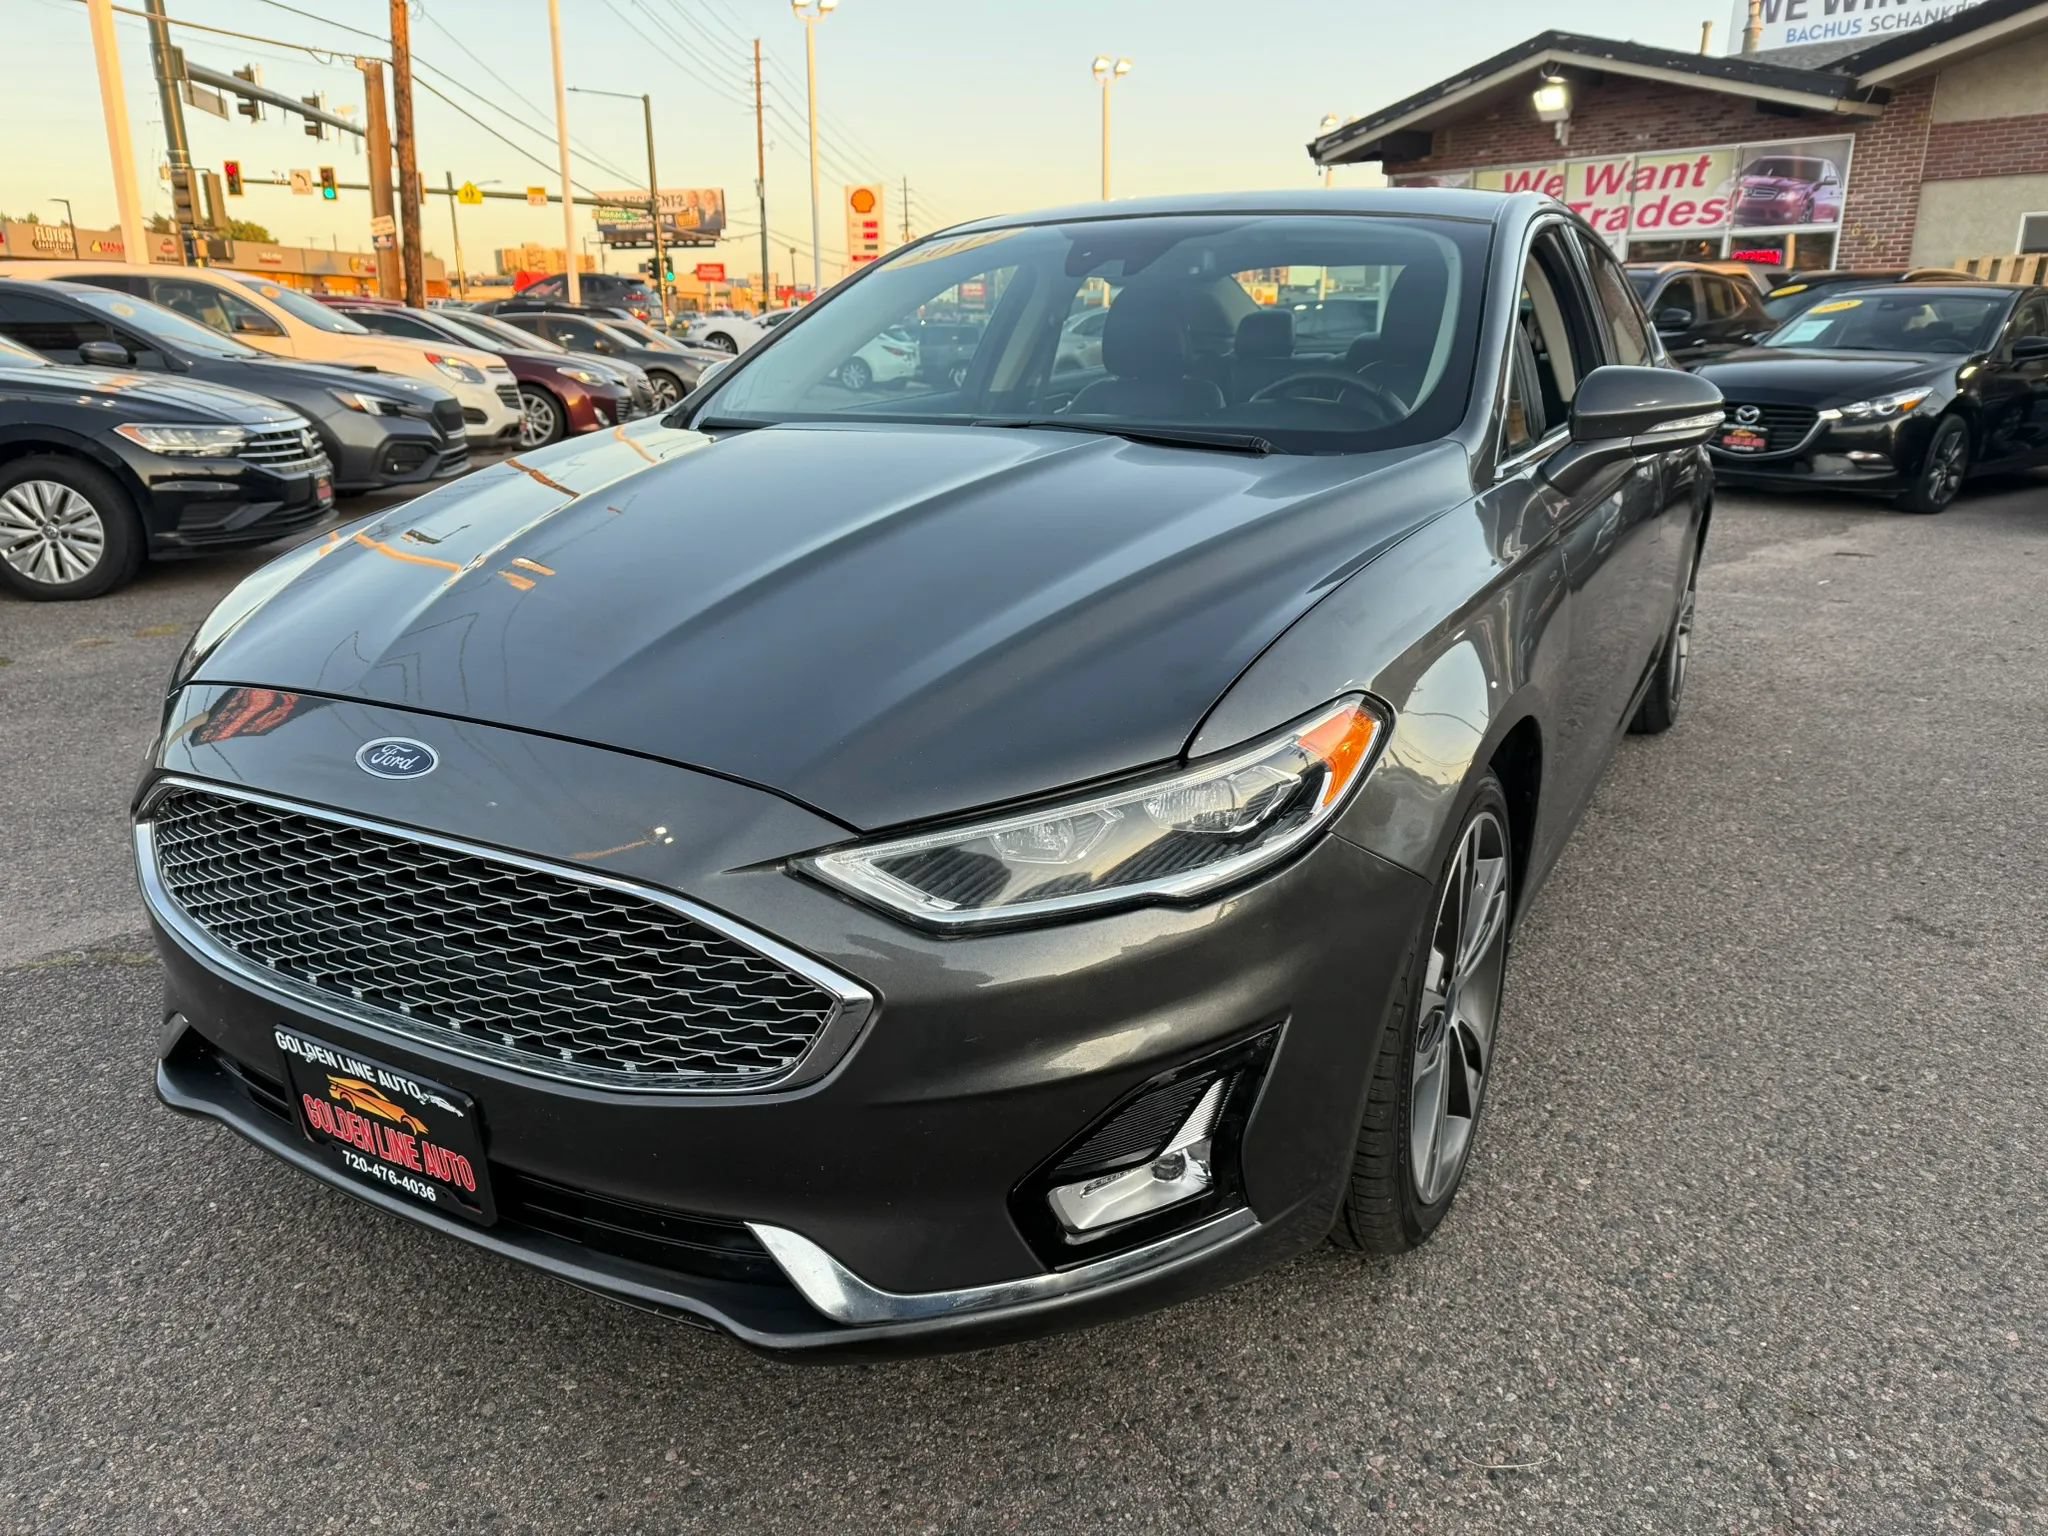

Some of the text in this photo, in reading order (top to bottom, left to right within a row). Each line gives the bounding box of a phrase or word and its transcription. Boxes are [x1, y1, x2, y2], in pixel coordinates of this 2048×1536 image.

[1785, 18, 1863, 43] BACHUS
[1504, 154, 1712, 197] We Want
[371, 744, 421, 770] Ford
[275, 1031, 421, 1100] GOLDEN LINE AUTO
[302, 1094, 477, 1193] GOLDEN LINE AUTO
[342, 1150, 437, 1202] 720-476-4036
